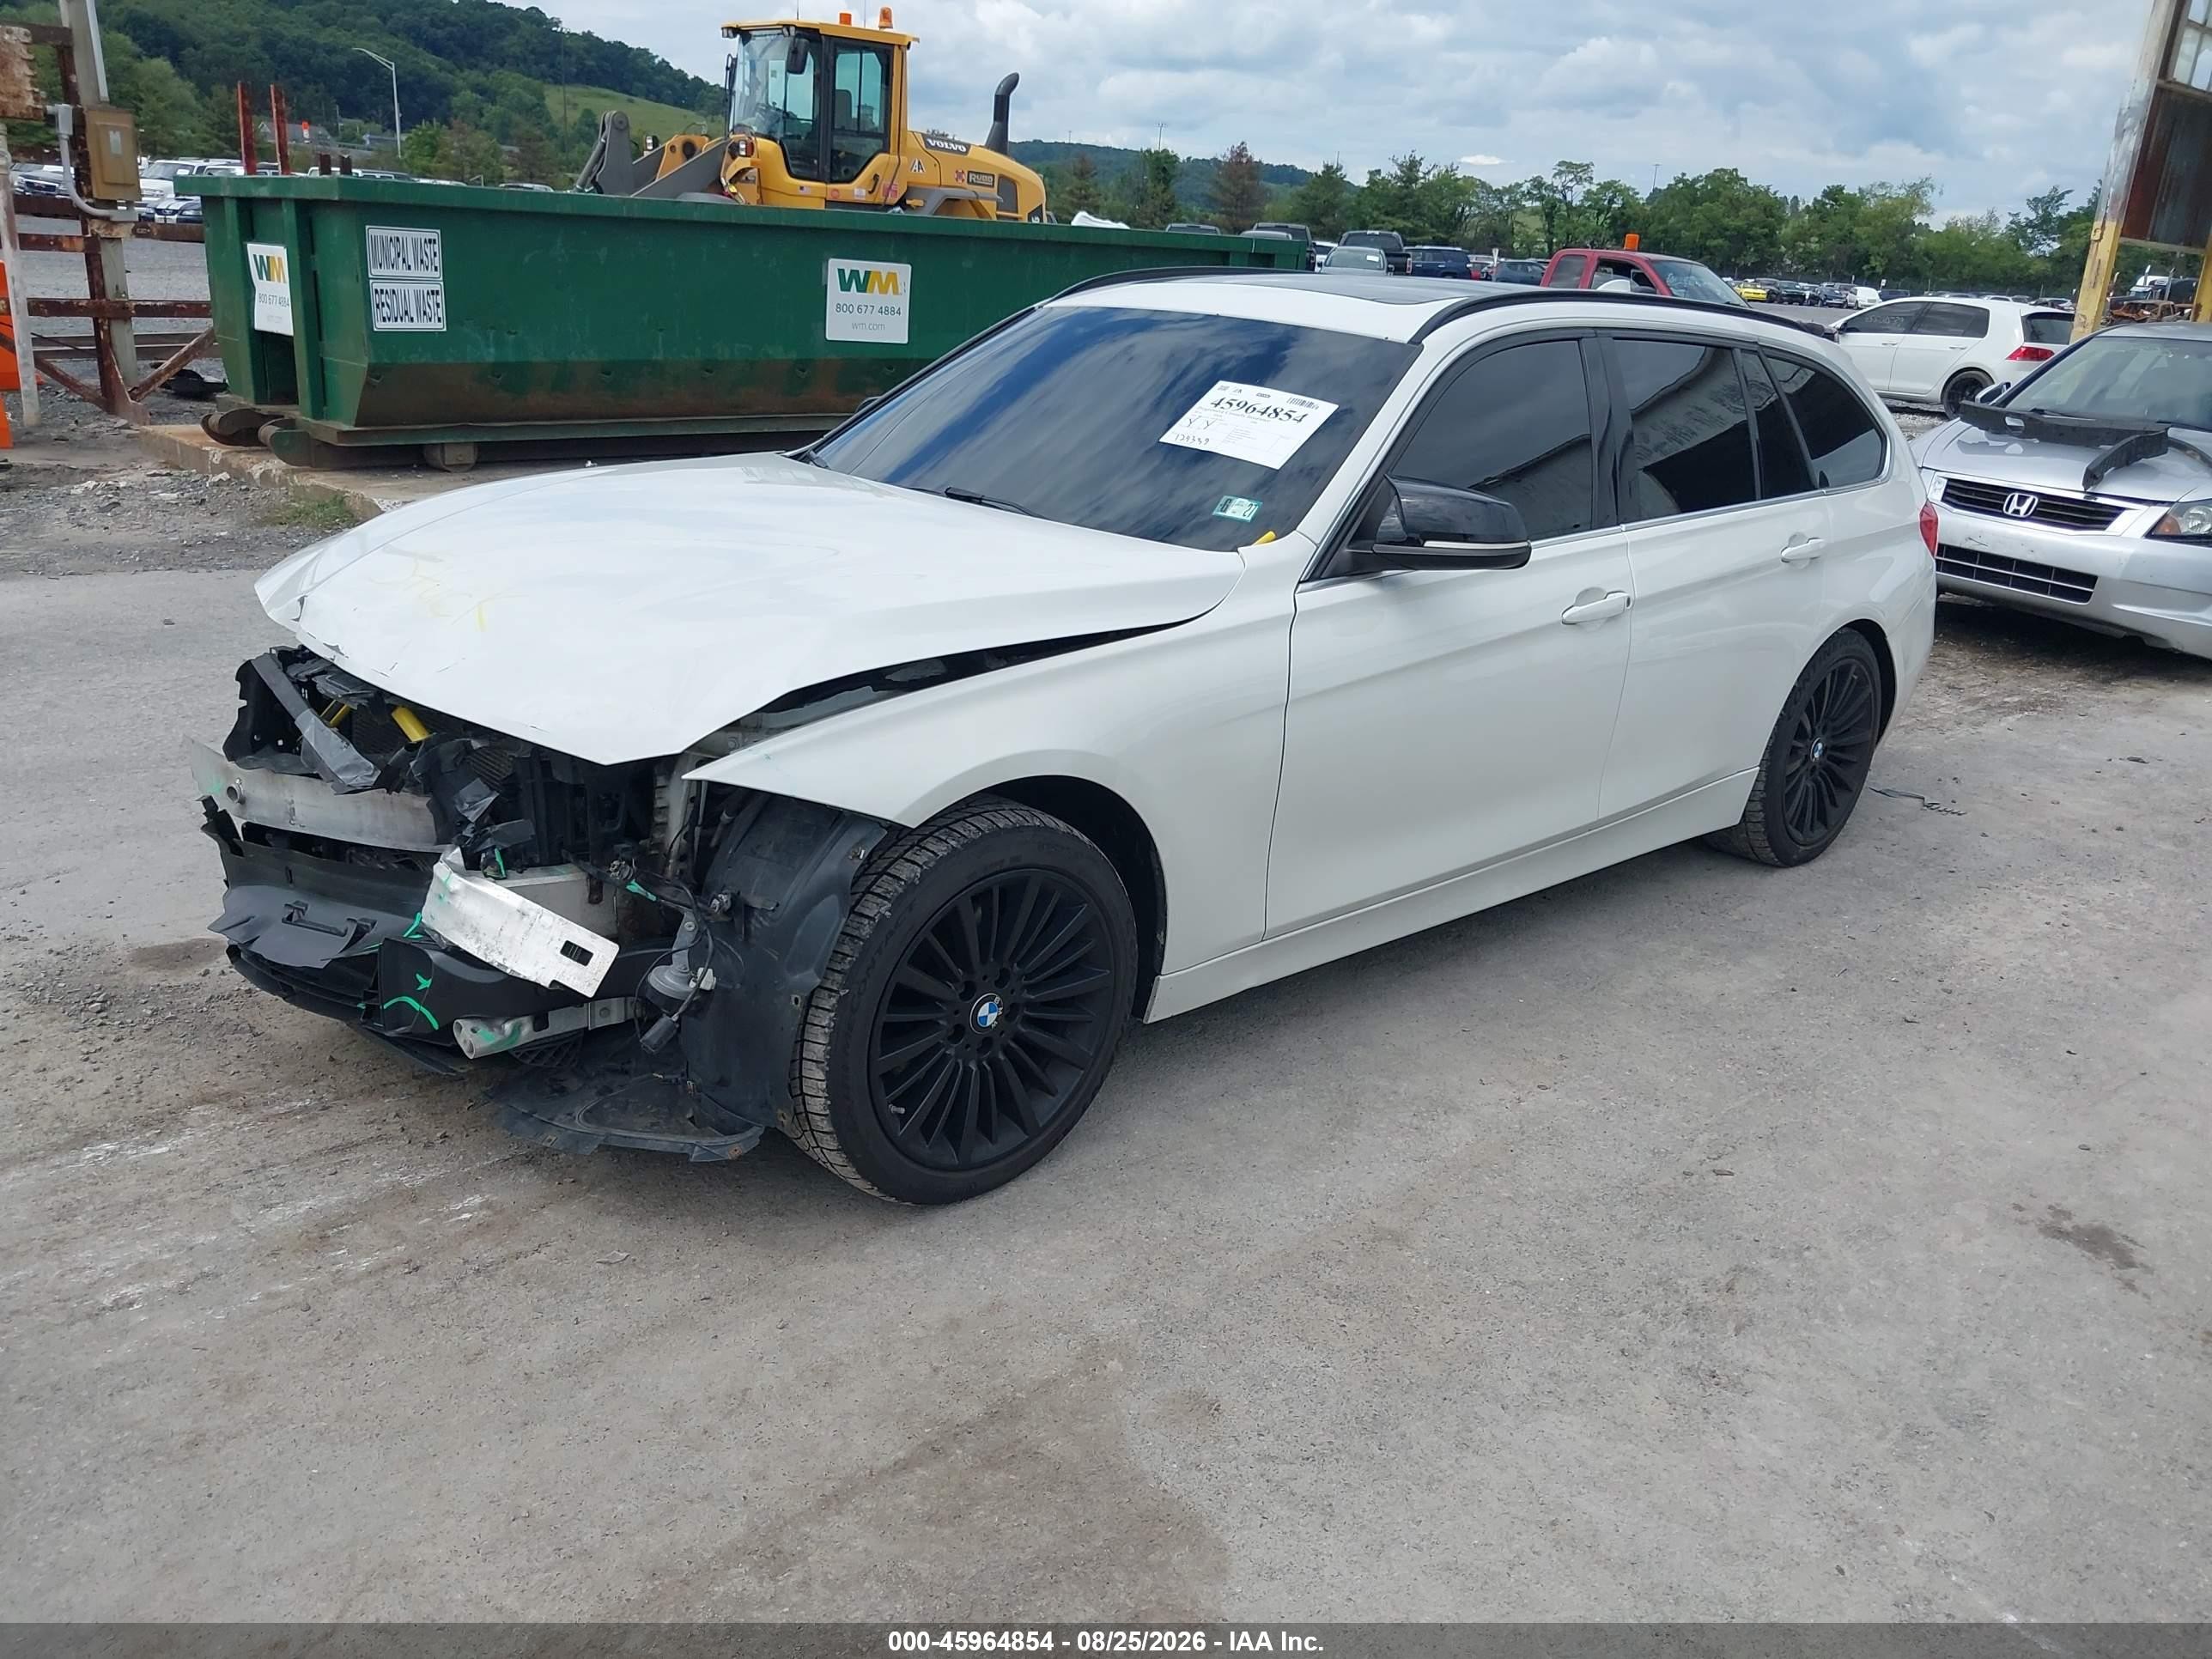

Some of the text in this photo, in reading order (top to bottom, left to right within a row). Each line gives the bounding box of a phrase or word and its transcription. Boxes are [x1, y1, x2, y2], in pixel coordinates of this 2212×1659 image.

[927, 137, 967, 153] VOLVO
[370, 234, 439, 272] MUNICIPAL WASTE
[252, 253, 287, 284] WM
[837, 268, 900, 296] WM
[374, 288, 442, 324] RESIDUAL WASTE
[836, 302, 901, 317] 800 677 4884
[1210, 397, 1308, 424] 45964854
